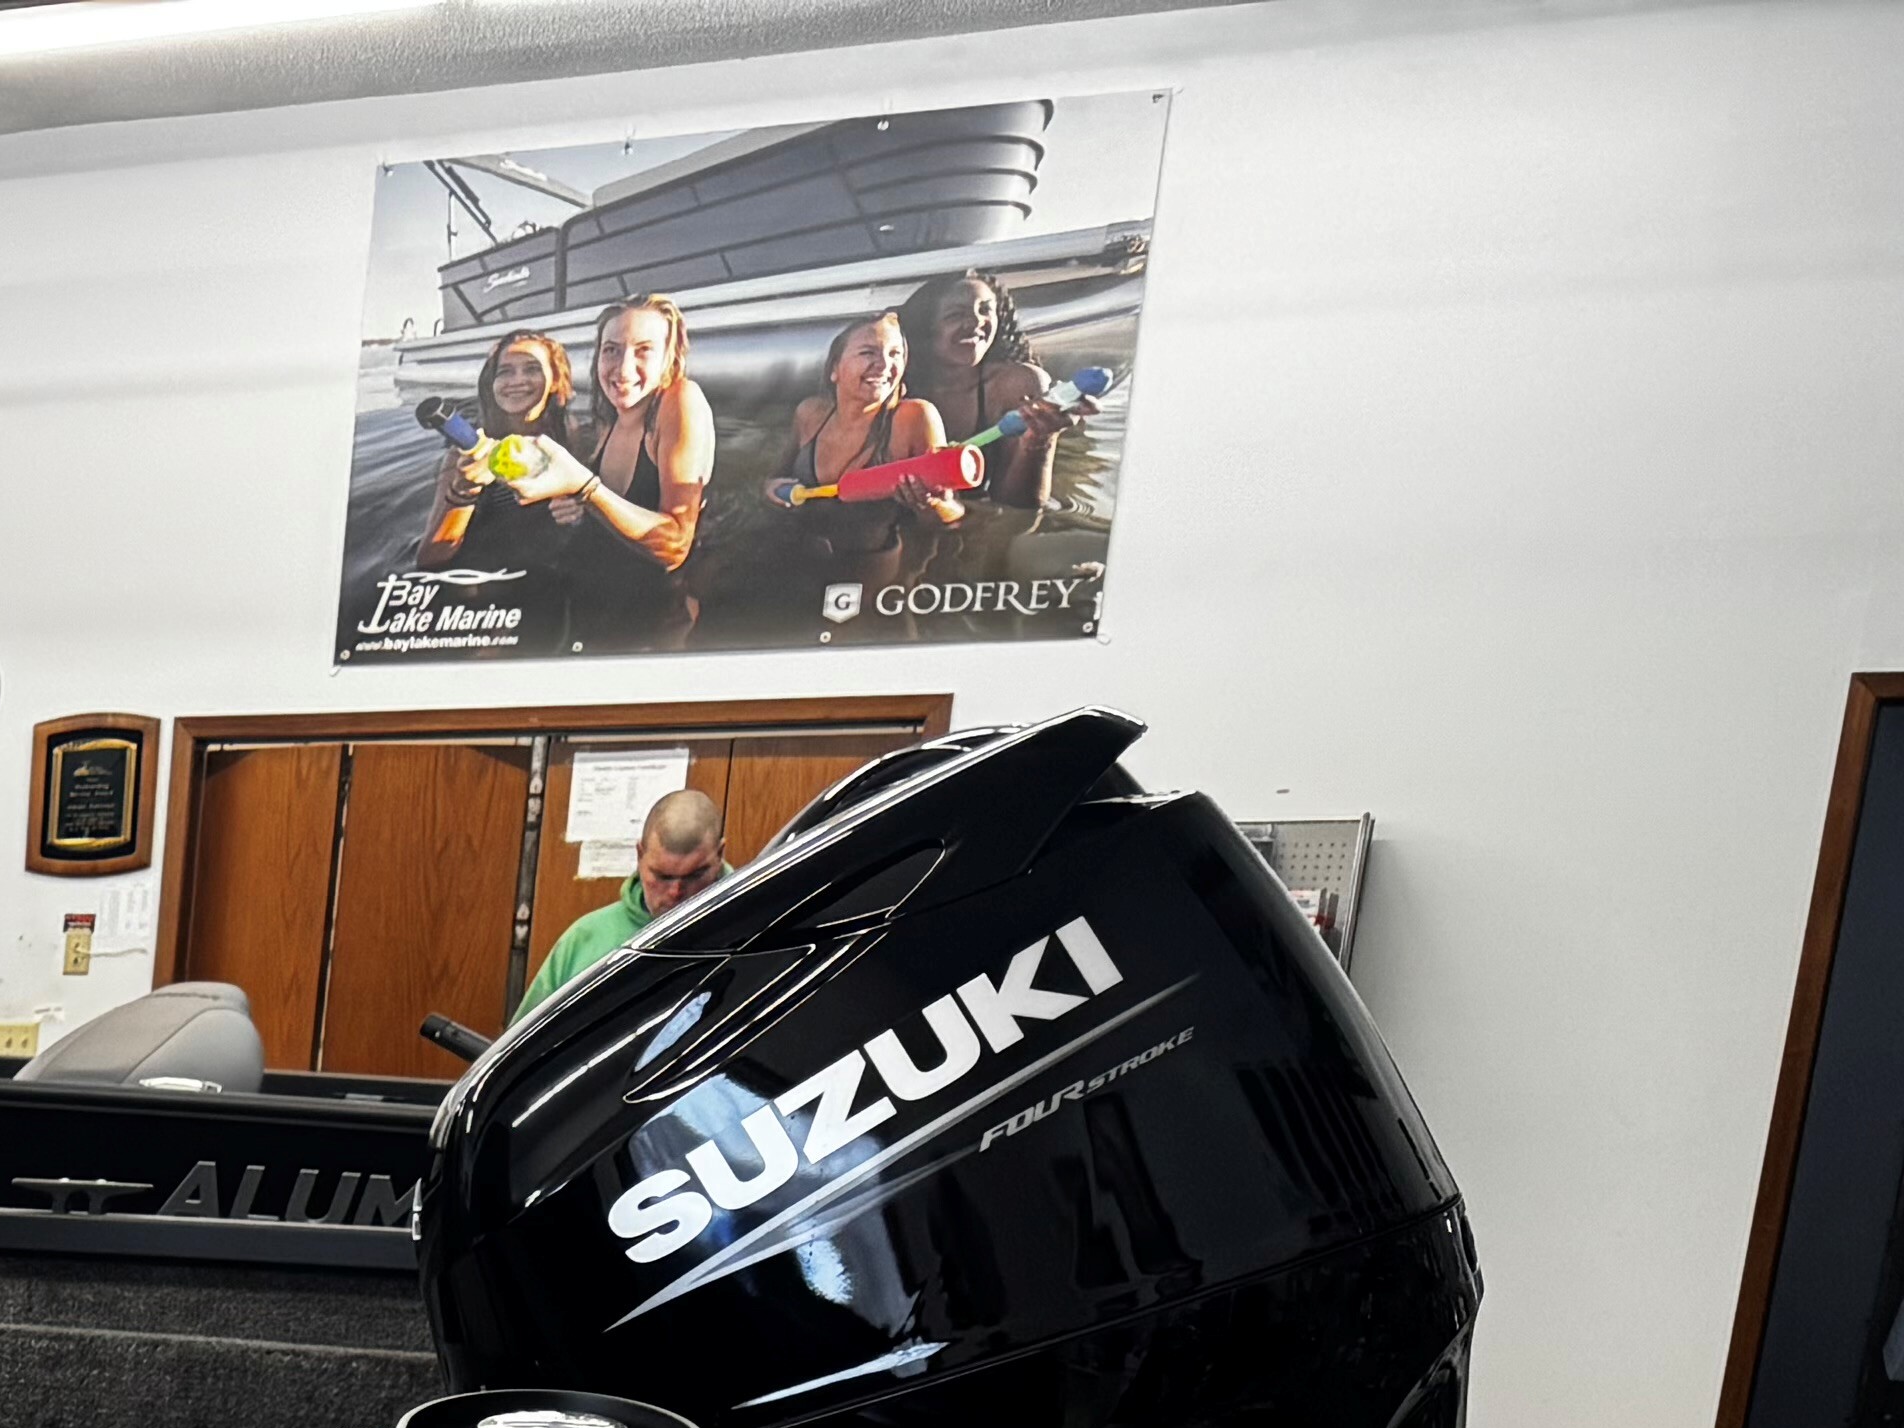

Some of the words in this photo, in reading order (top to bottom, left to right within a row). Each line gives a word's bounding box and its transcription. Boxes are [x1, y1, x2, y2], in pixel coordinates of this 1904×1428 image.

[376, 573, 441, 610] Bay
[875, 578, 1085, 616] GODFREY
[357, 597, 434, 634] Lake
[435, 603, 523, 632] Marine
[606, 915, 1124, 1265] SUZUKI
